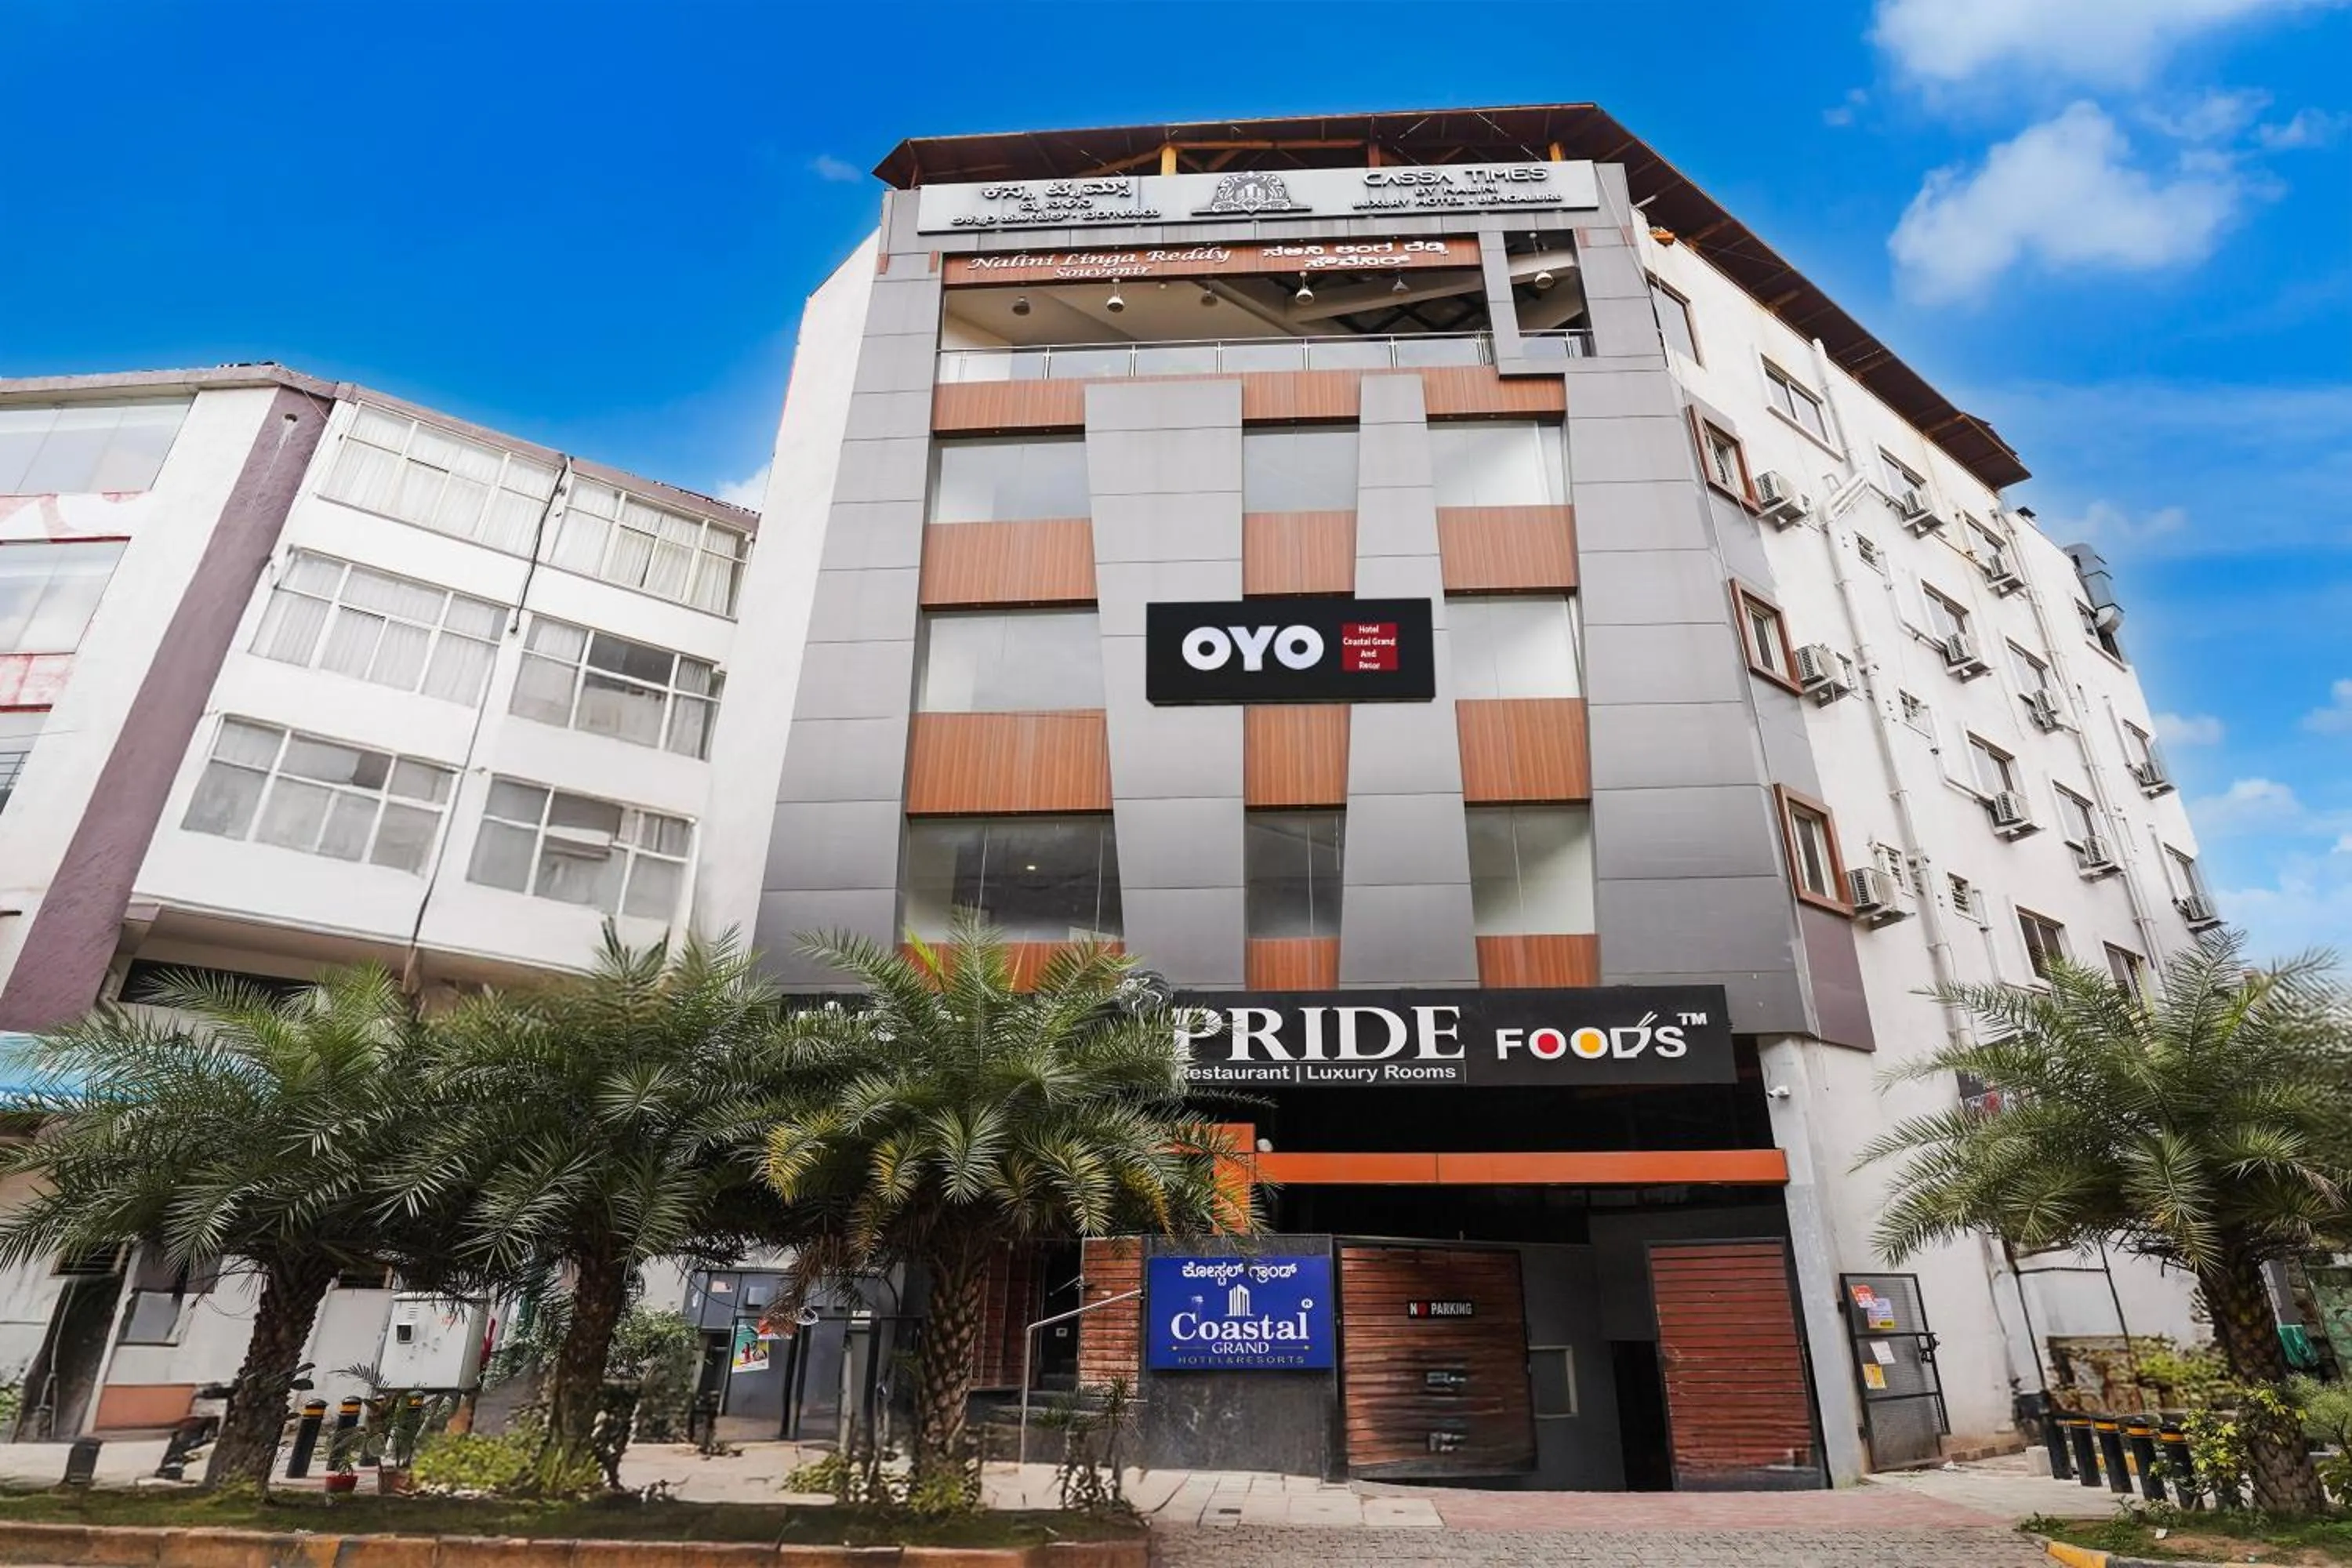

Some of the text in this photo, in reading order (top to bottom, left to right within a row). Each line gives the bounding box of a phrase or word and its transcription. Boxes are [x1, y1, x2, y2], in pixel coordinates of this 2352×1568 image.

[1363, 167, 1548, 188] CASSA TIMES
[1415, 183, 1499, 197] BY NALINI
[1352, 192, 1563, 210] LUXURY HOTEL BENGALURU
[967, 247, 1232, 270] Nalini Linga Reddy
[1053, 264, 1153, 279] Souvenir
[1359, 624, 1379, 634] Hotel
[1181, 625, 1324, 672] OYO
[1343, 637, 1396, 646] Coastal Grand
[1360, 649, 1377, 658] And
[1676, 1012, 1708, 1025] TM
[1173, 1006, 1465, 1062] PRIDE
[1307, 1065, 1378, 1083] Luxury
[1385, 1064, 1457, 1080] Rooms
[1431, 1302, 1472, 1315] PARKING
[1171, 1311, 1310, 1341] Coastal
[1211, 1341, 1270, 1355] GRAND
